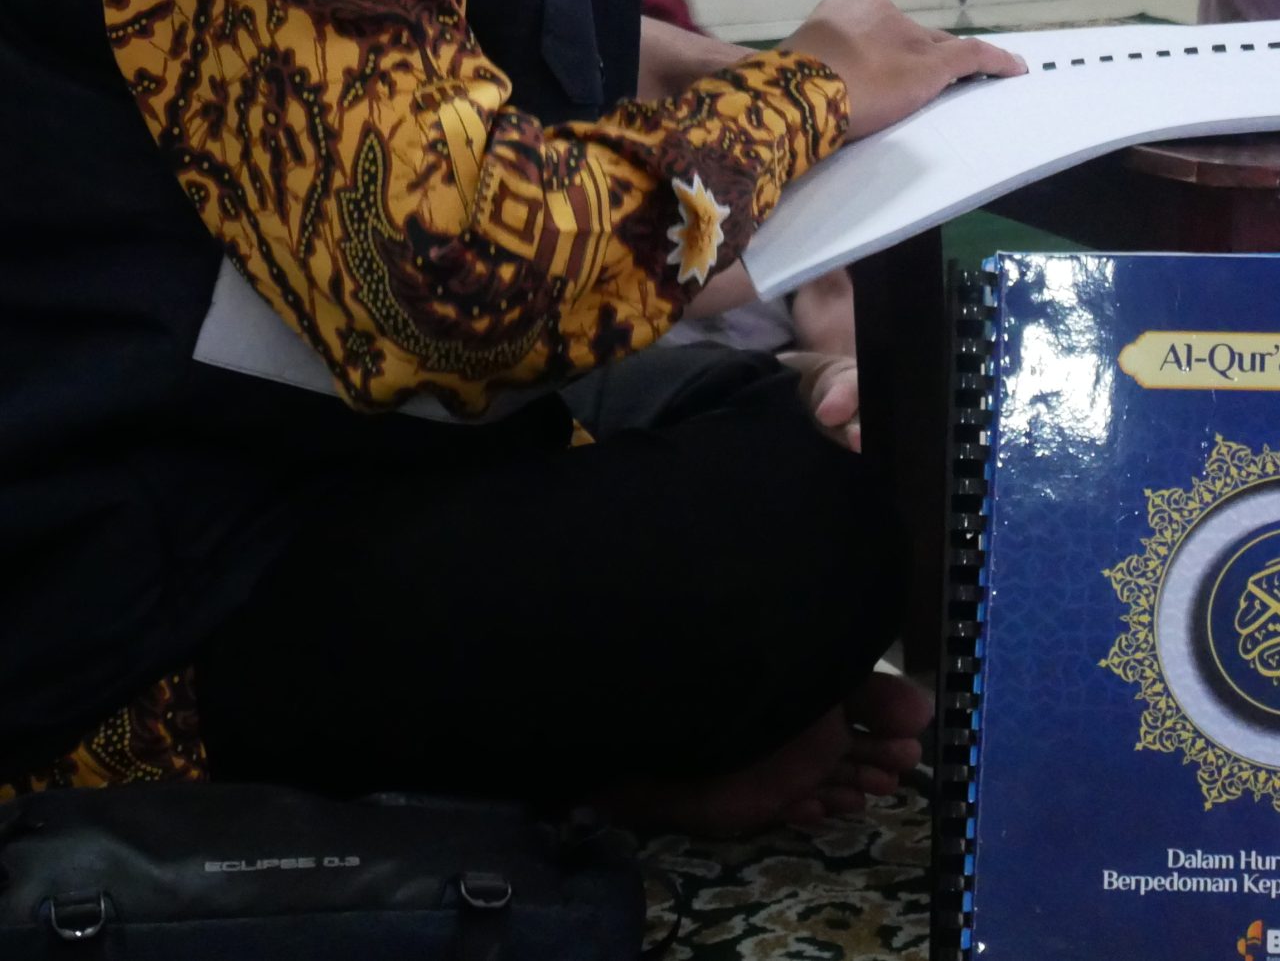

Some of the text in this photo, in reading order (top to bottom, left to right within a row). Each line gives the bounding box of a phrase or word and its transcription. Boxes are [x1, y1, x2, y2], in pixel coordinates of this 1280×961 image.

[204, 857, 316, 872] ECLIPSE
[1167, 848, 1235, 870] Dalam
[1103, 870, 1237, 895] Berpedoman
